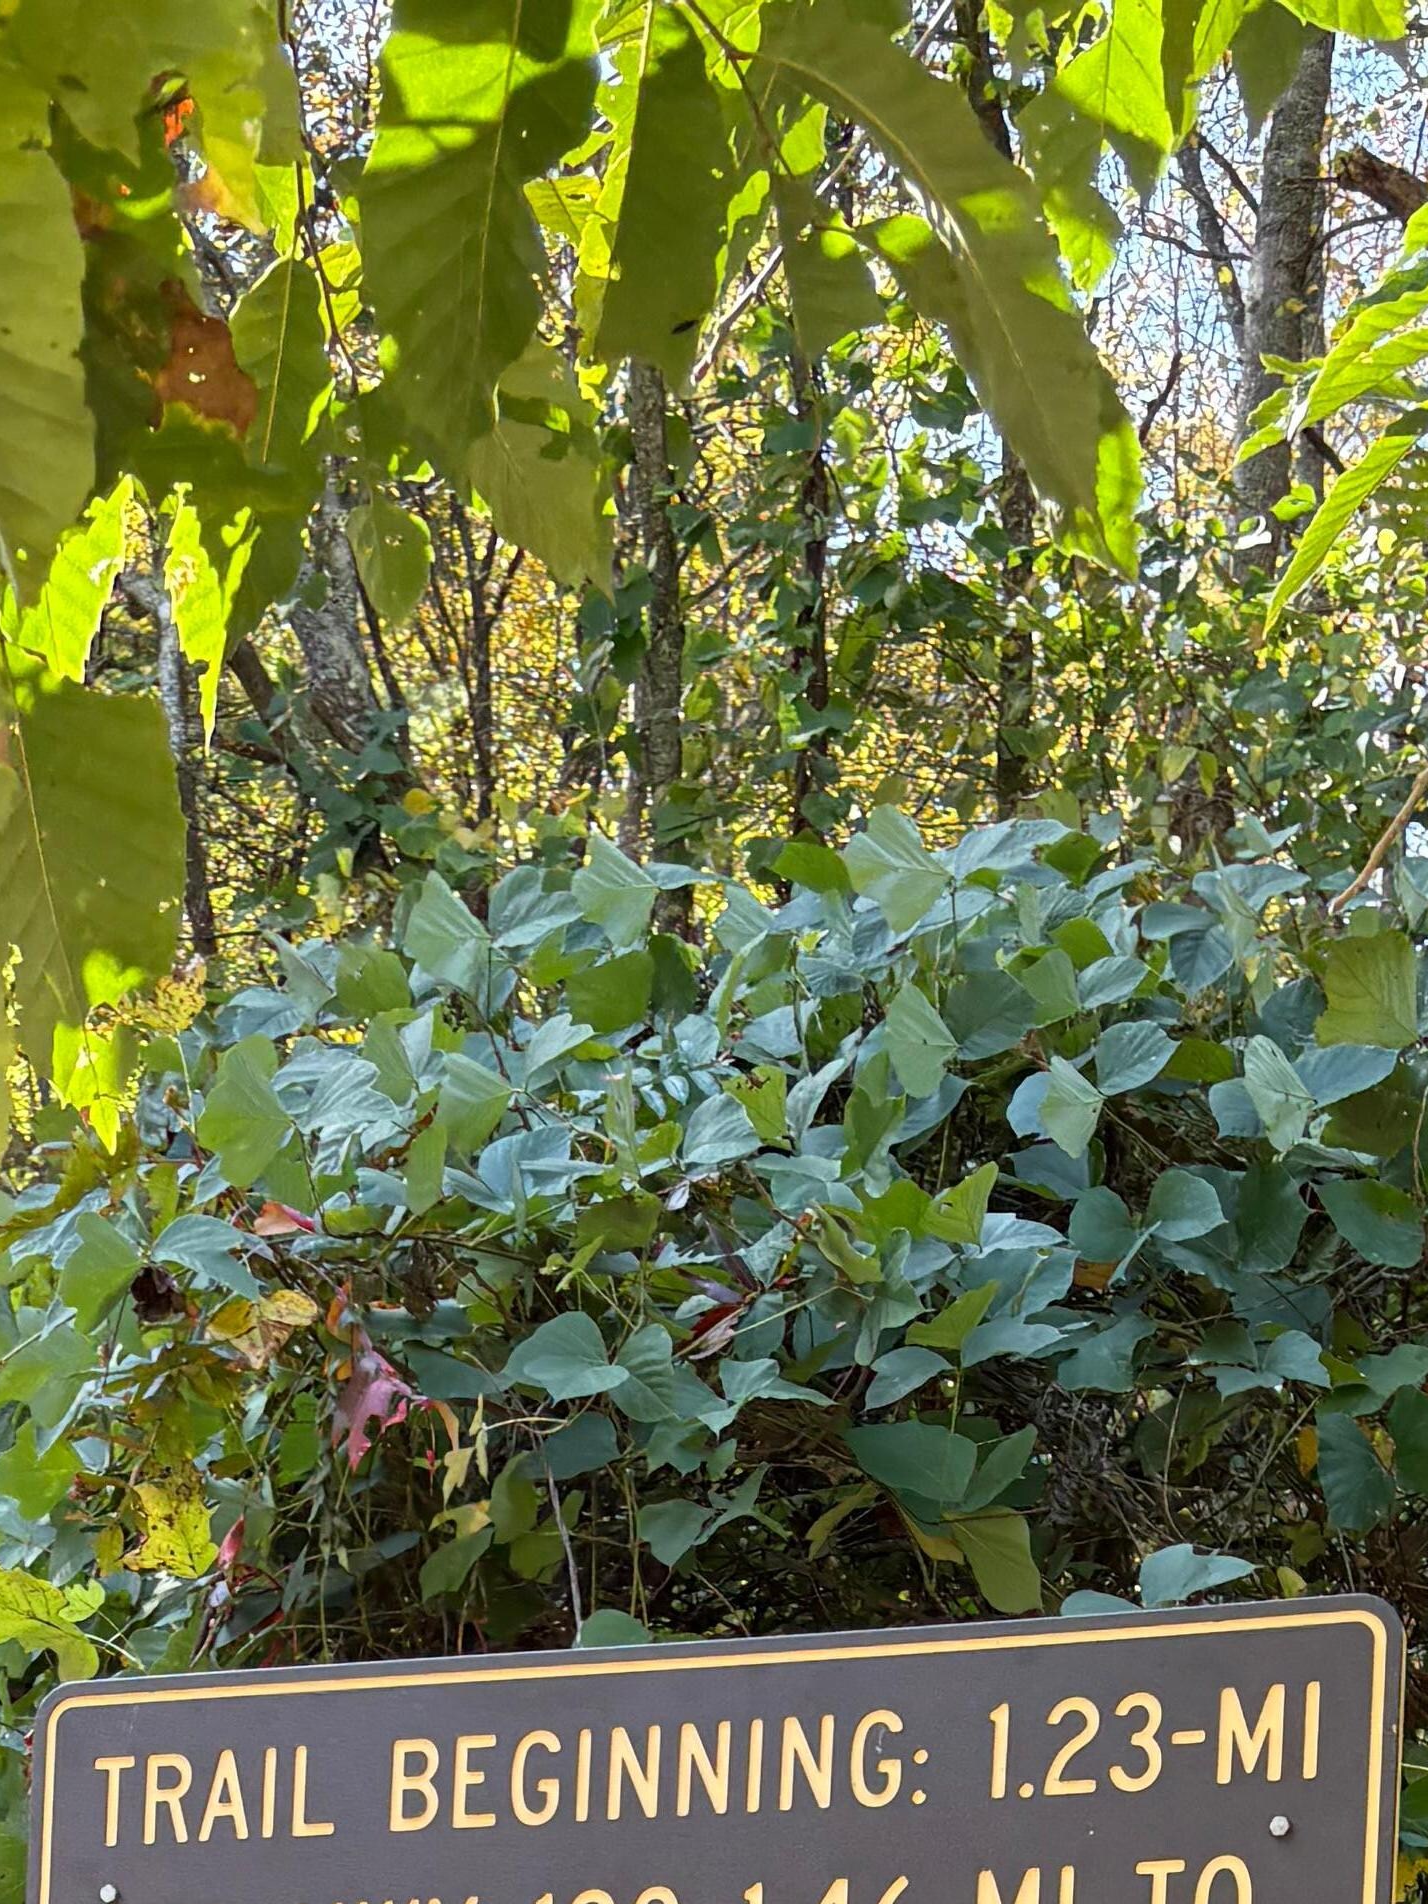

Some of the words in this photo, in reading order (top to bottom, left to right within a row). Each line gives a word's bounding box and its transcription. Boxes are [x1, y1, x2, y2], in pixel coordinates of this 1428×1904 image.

[94, 1745, 334, 1847] TRAIL
[390, 1710, 928, 1831] BEGINNING:
[990, 1681, 1320, 1798] 1.23-MI
